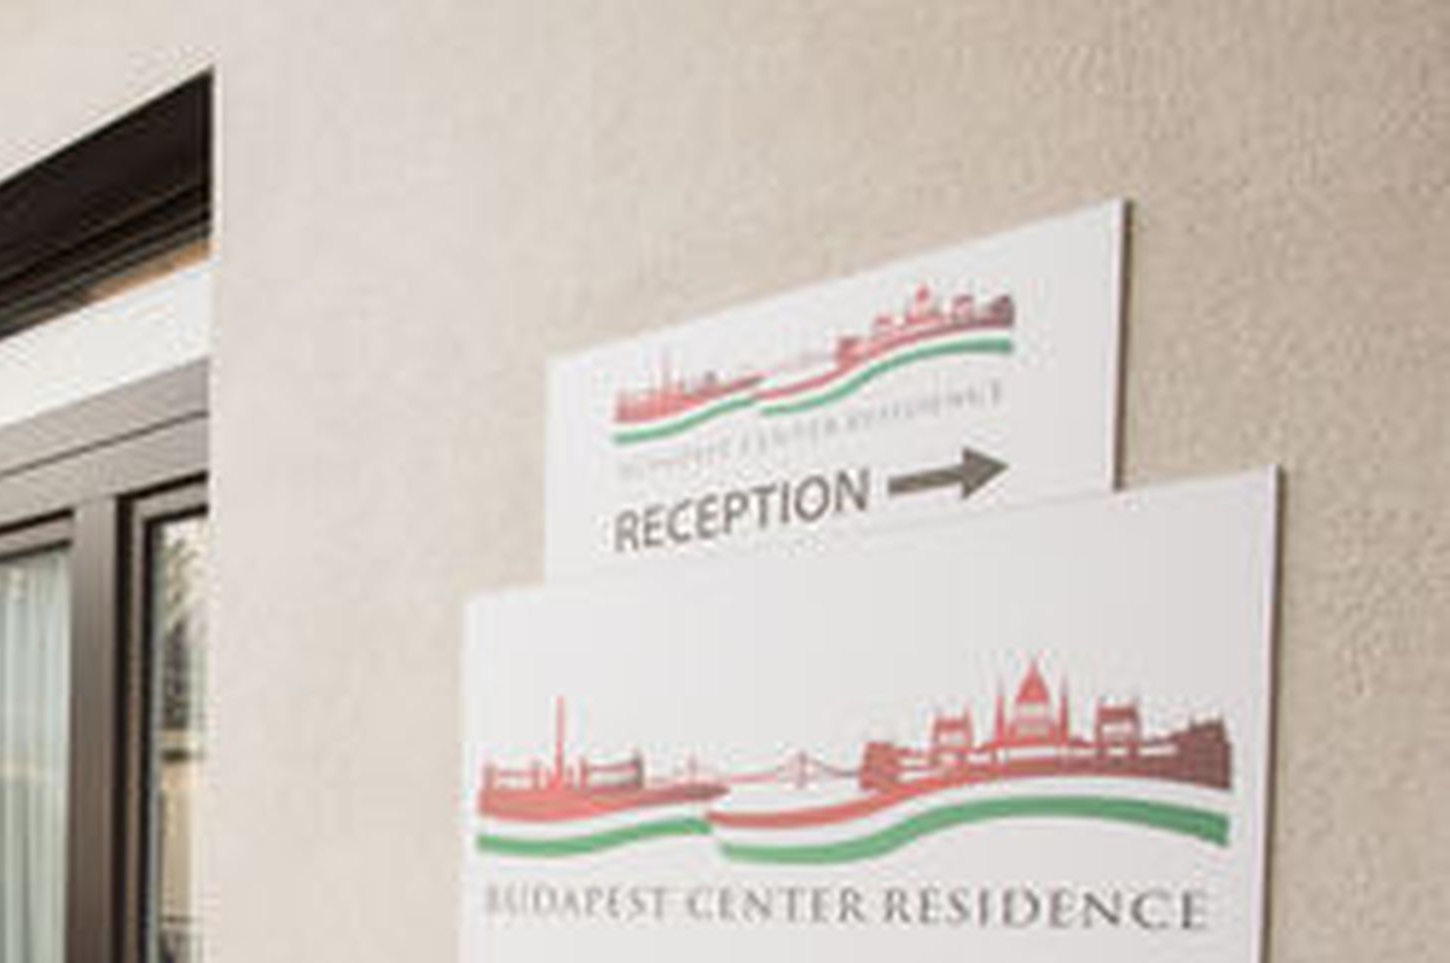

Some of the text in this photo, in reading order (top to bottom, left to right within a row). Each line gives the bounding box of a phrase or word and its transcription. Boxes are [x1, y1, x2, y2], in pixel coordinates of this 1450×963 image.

[614, 468, 870, 552] RECEPTION
[487, 885, 1207, 930] BUDAPEST CENTER RESIDENCE
